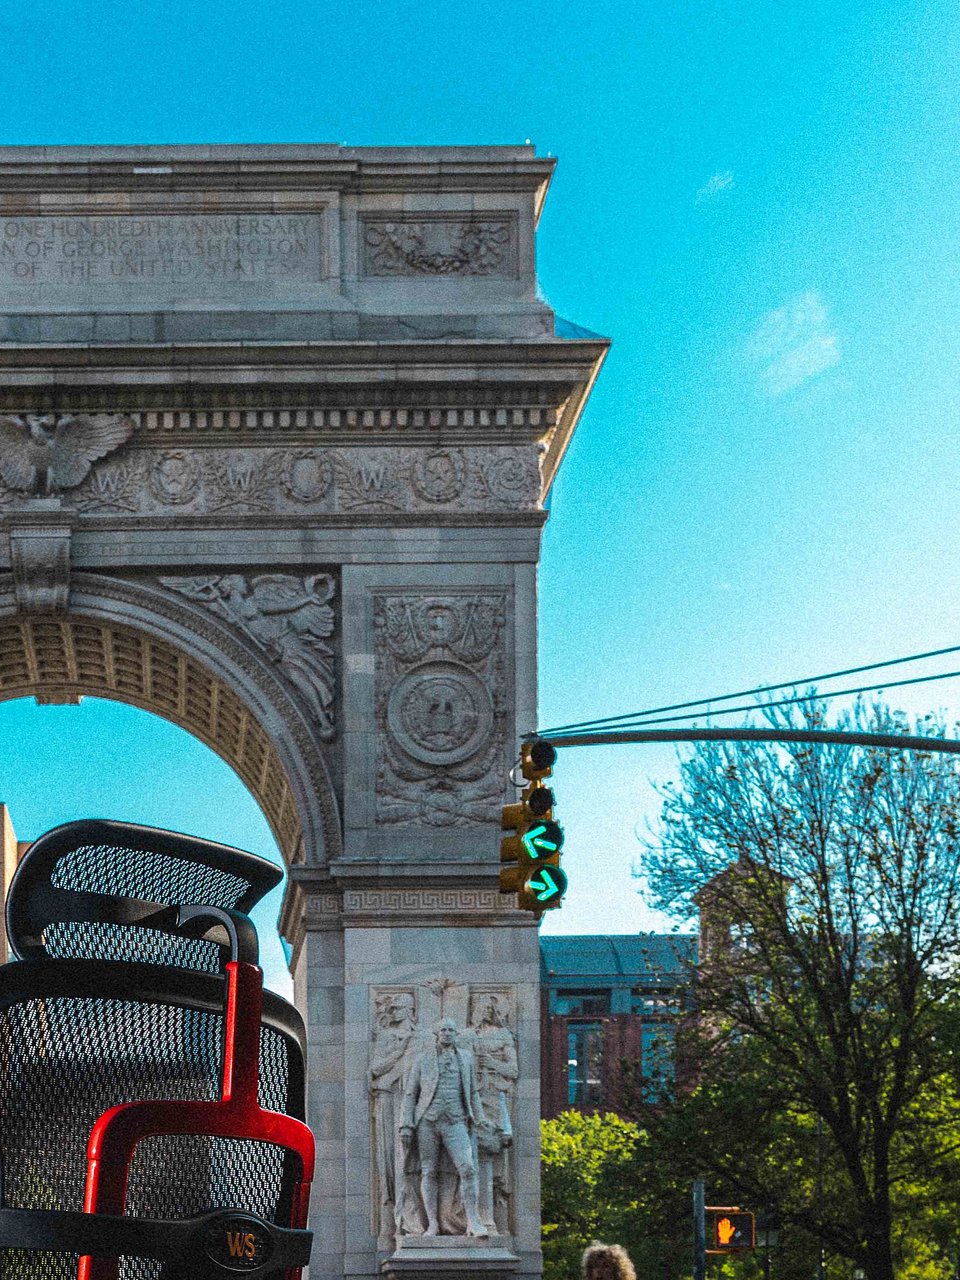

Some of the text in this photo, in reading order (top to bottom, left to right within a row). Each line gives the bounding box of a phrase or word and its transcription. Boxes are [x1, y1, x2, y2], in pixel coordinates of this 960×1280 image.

[5, 220, 45, 238] ONE
[51, 219, 172, 238] HUNDREDTH
[177, 218, 311, 237] ANNIVERSARY
[25, 240, 55, 258] OF
[62, 240, 147, 258] GEORGE
[158, 238, 310, 257] WASHINGTON
[14, 261, 42, 278] OF
[57, 260, 99, 278] THE
[110, 259, 192, 277] UNITED
[205, 258, 298, 276] STATES
[227, 1231, 256, 1258] WS
